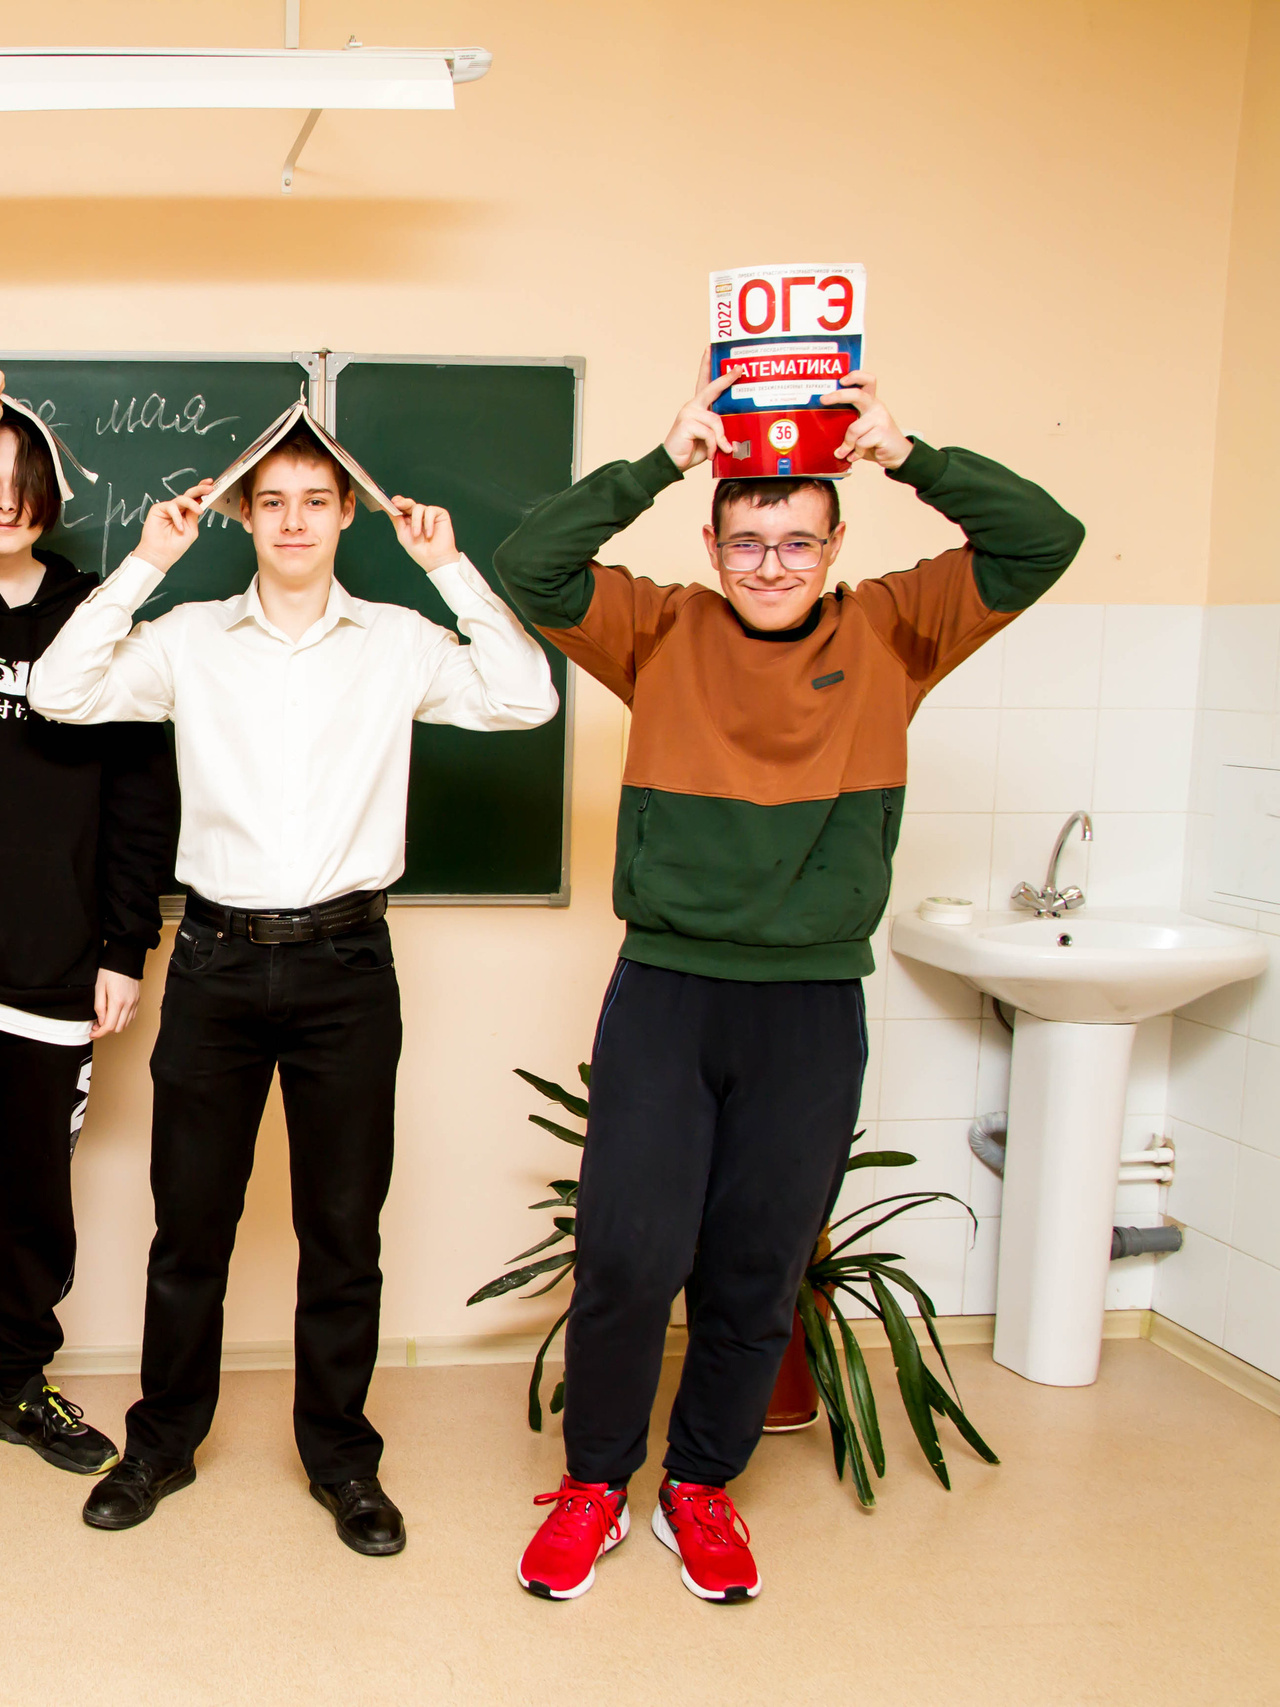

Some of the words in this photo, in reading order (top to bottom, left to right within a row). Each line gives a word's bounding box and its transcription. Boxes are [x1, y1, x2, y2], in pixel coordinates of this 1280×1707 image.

[717, 300, 732, 338] 2022
[738, 275, 854, 335] ОГЭ
[776, 425, 792, 440] 36
